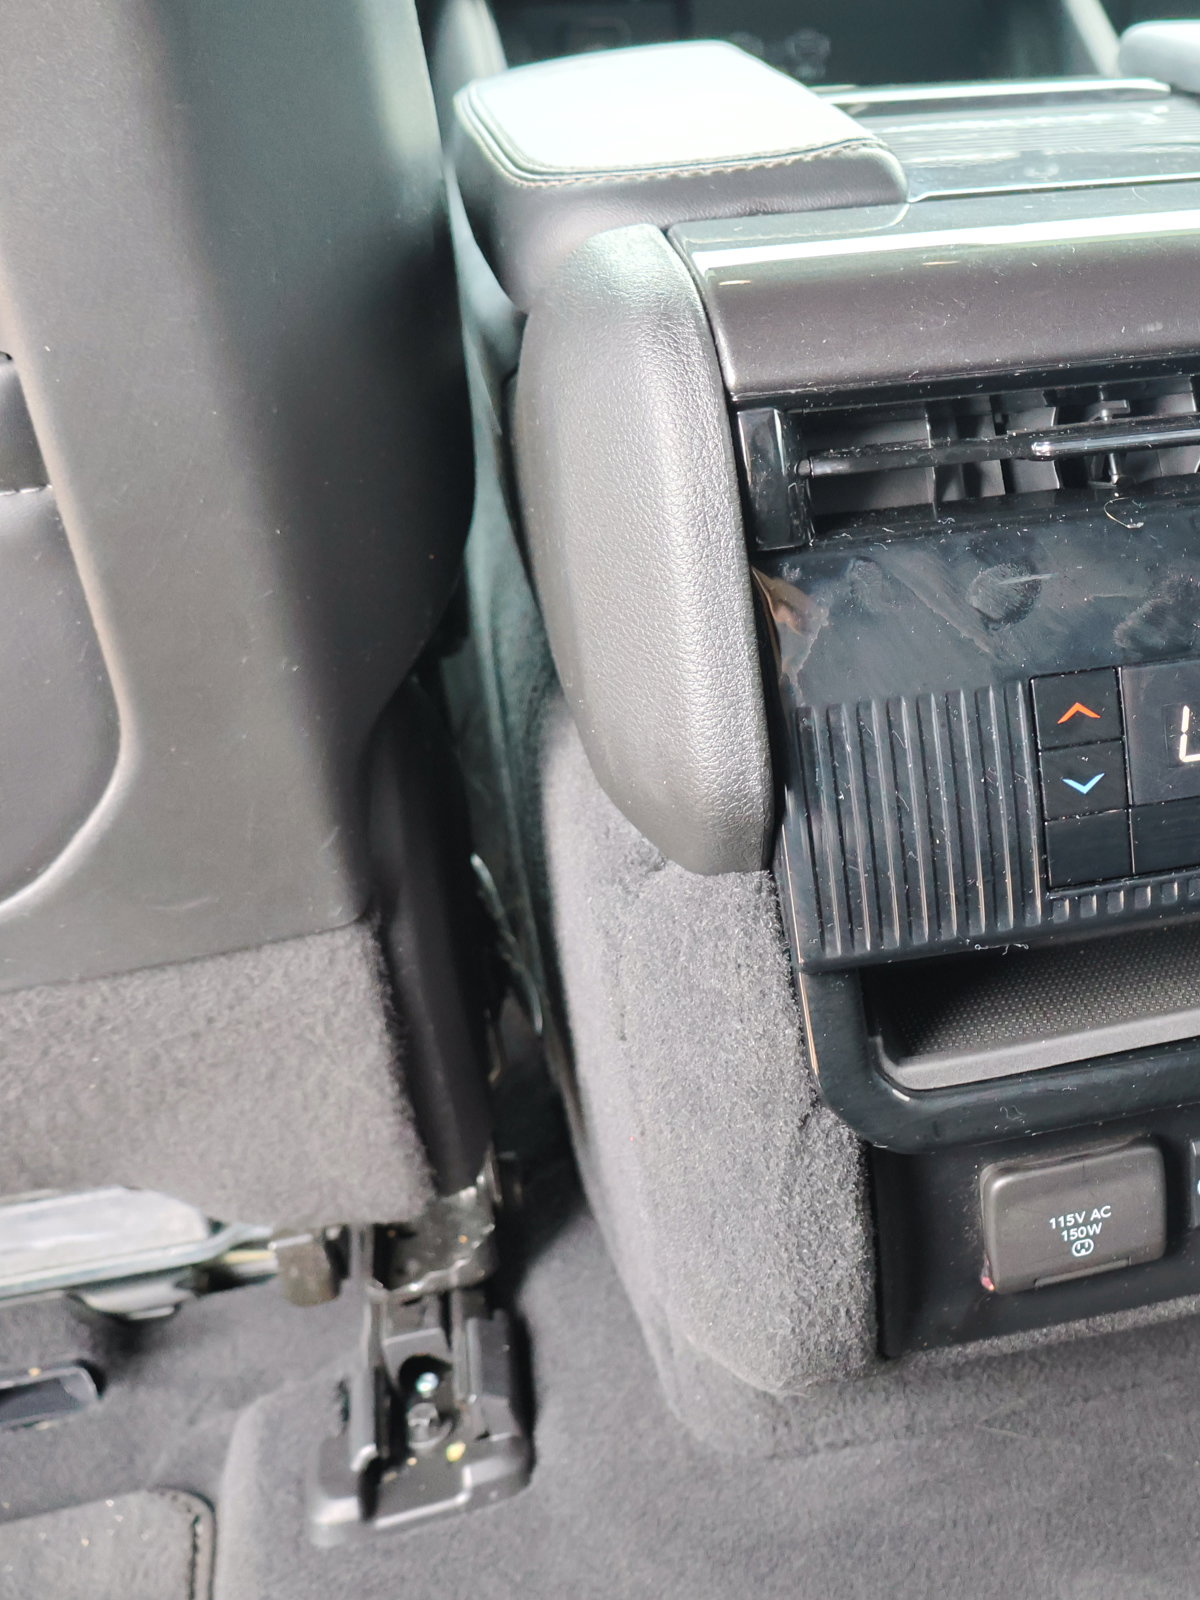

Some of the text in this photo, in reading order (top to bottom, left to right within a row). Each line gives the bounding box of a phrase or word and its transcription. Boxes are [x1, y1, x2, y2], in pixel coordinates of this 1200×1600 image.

[1049, 1205, 1112, 1229] 115V AC
[1061, 1222, 1102, 1242] 150W
